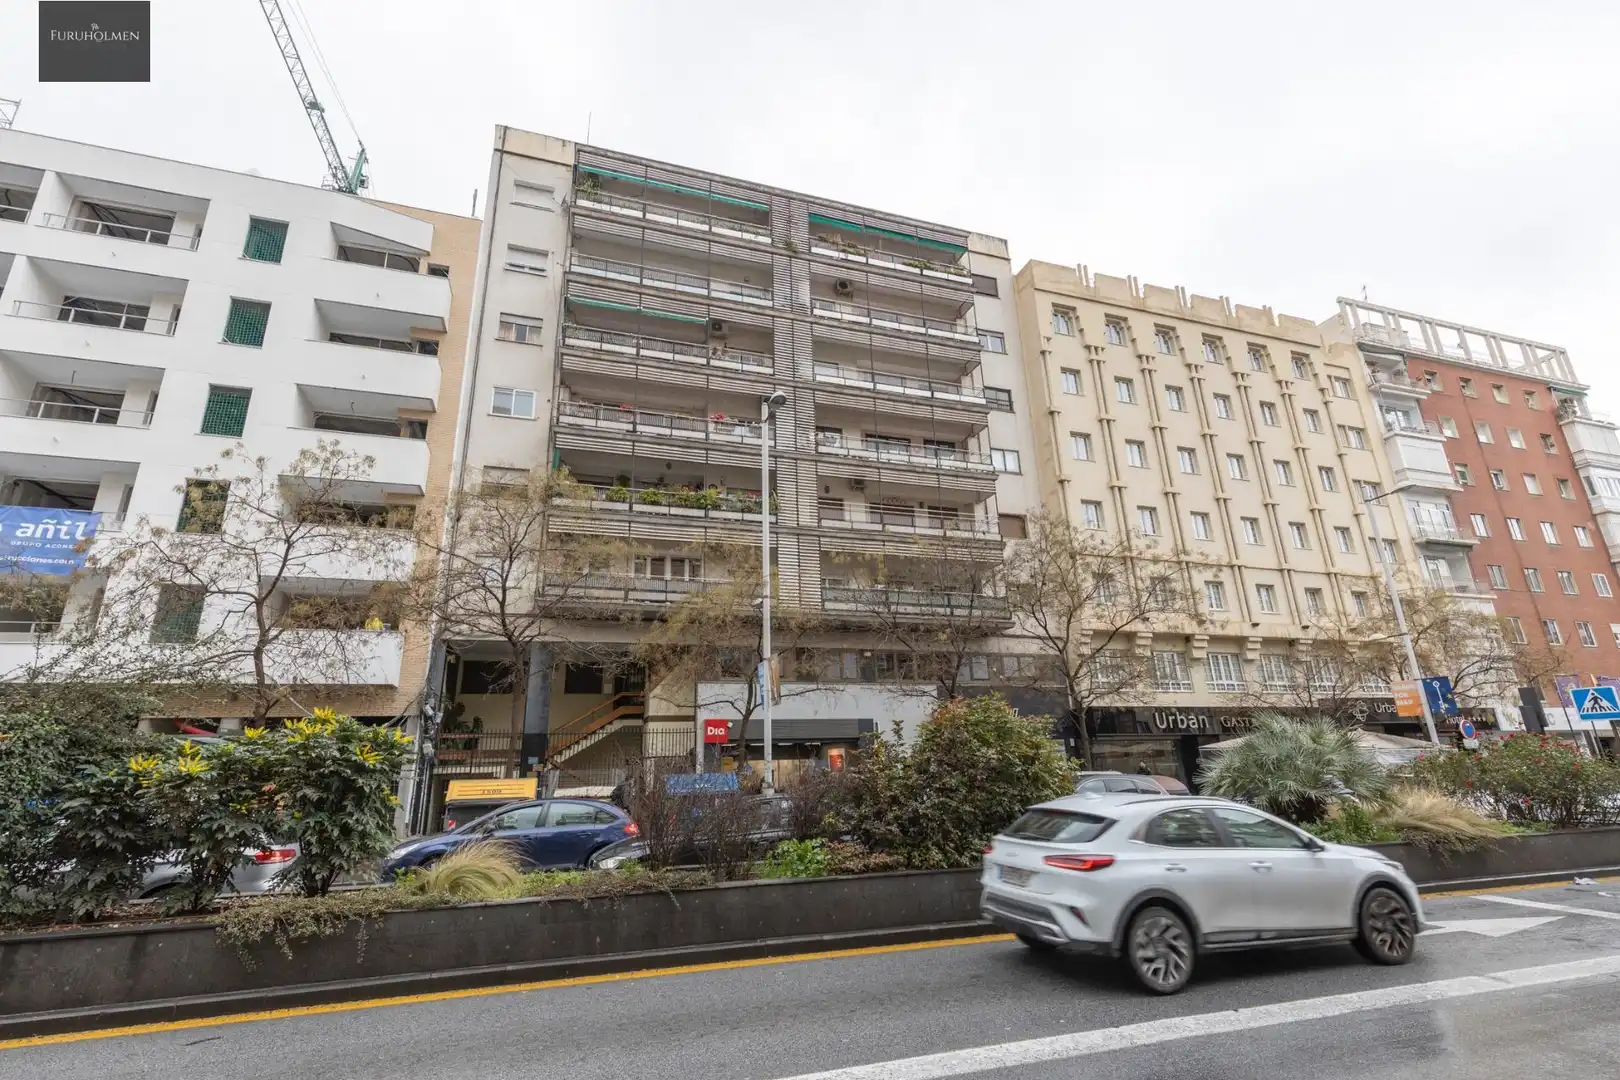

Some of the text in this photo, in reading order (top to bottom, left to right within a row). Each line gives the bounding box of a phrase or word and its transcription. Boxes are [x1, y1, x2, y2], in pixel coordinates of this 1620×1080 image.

[15, 518, 87, 541] añil
[1374, 702, 1397, 713] Urba
[1155, 711, 1209, 729] Urban
[1220, 716, 1252, 727] GAST
